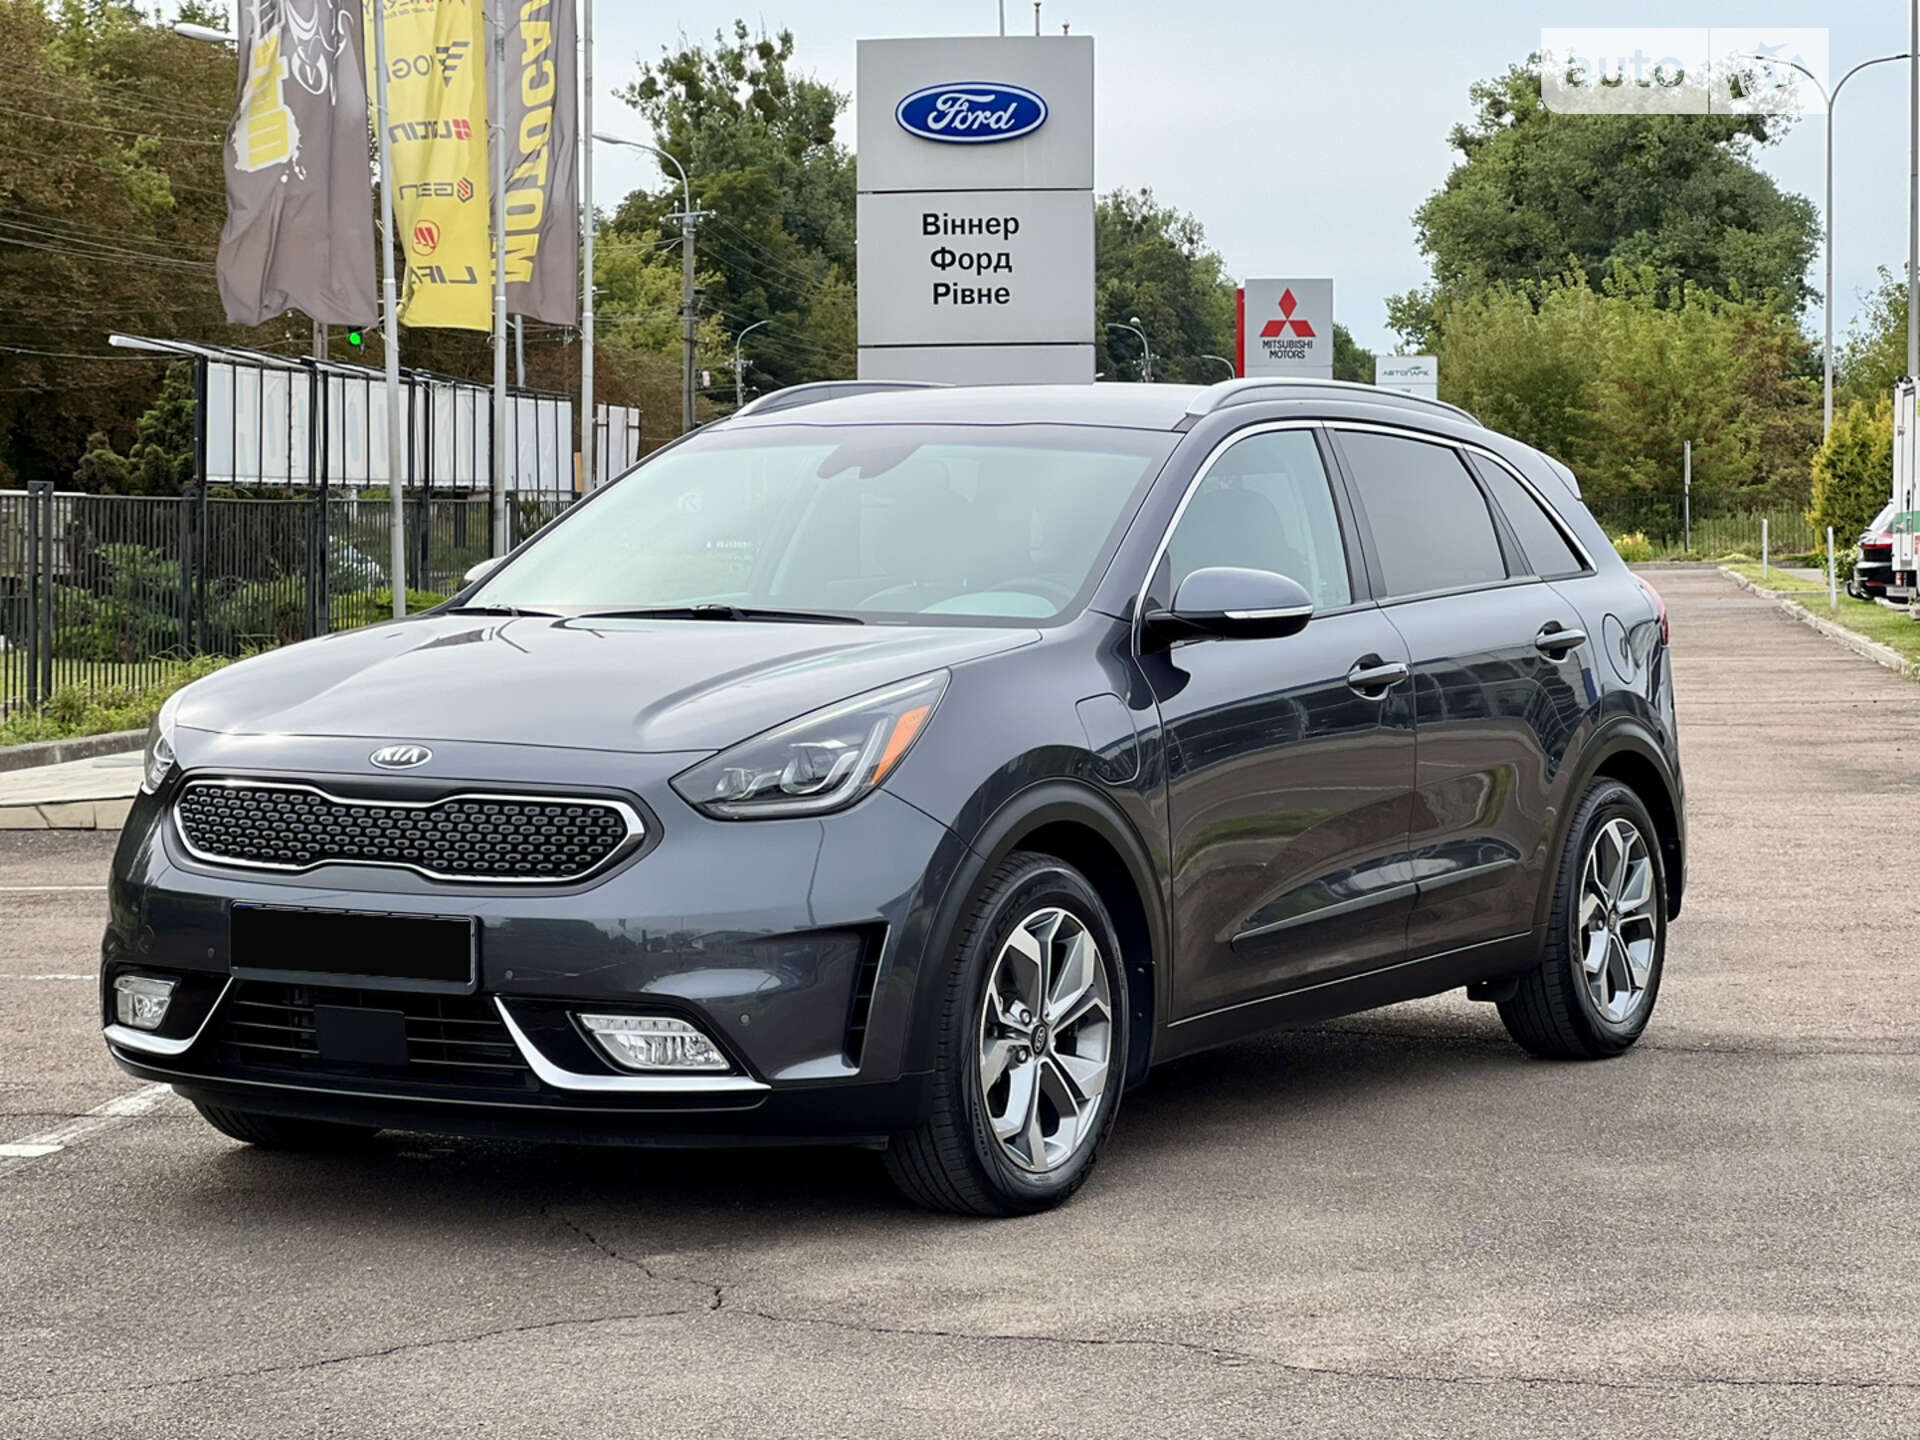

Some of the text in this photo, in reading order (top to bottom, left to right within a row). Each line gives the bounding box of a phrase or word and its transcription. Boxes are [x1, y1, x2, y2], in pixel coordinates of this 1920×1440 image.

[927, 93, 1018, 130] Ford
[922, 213, 1020, 240] Віннер
[930, 246, 1013, 275] Форд
[932, 282, 1010, 304] Рівне
[1262, 340, 1313, 350] MITSUBISHI
[1269, 350, 1306, 360] MOTORS
[377, 746, 421, 763] KIA
